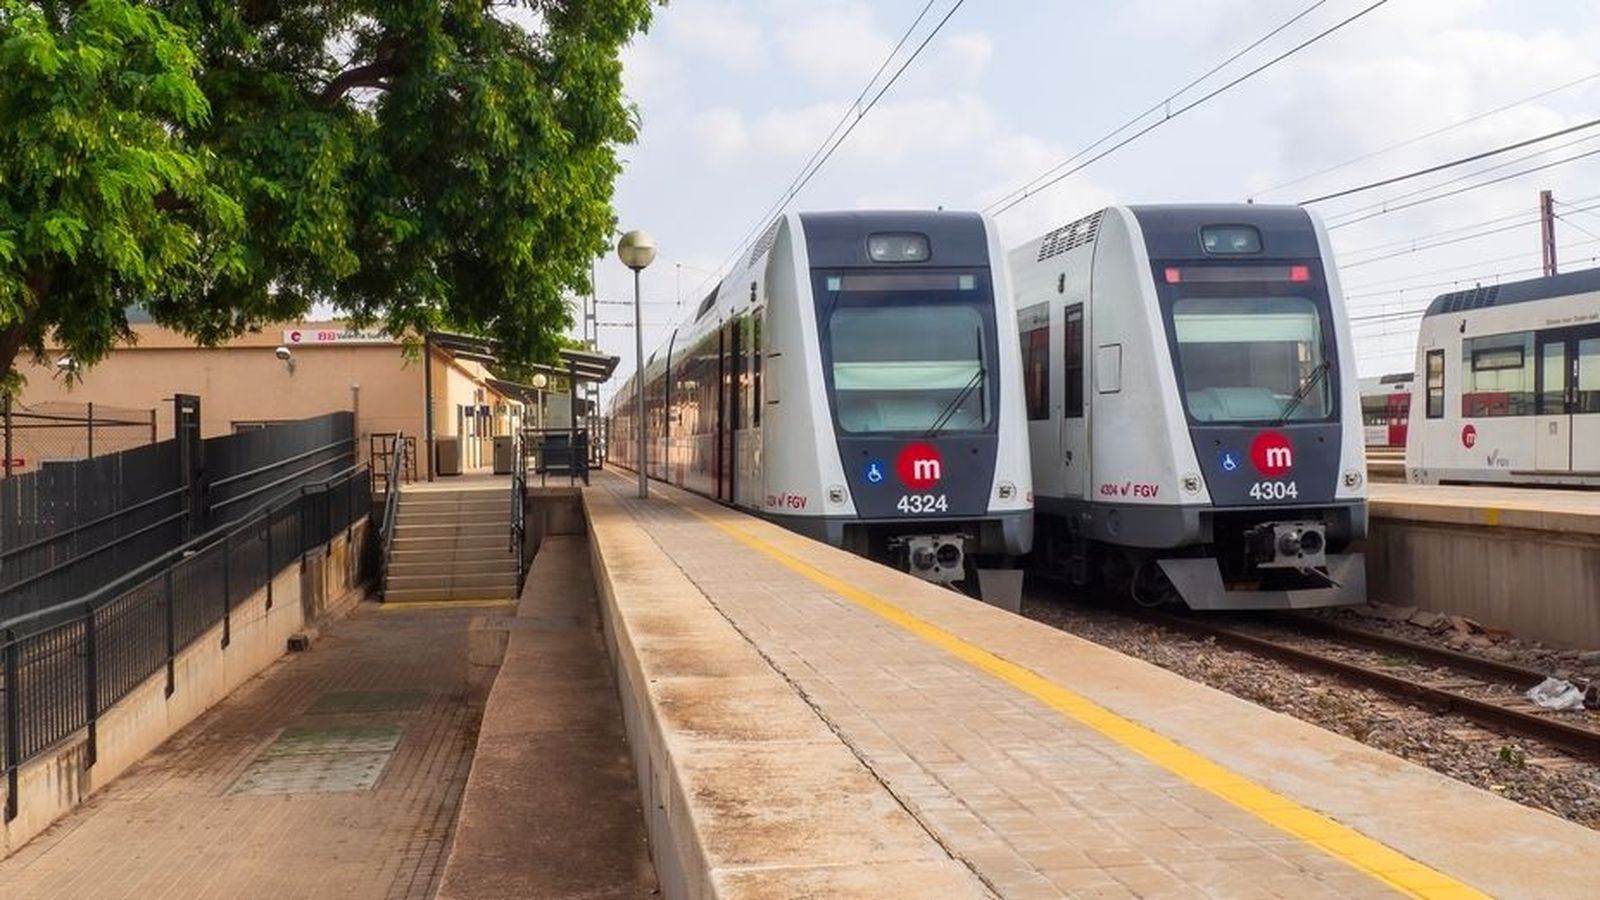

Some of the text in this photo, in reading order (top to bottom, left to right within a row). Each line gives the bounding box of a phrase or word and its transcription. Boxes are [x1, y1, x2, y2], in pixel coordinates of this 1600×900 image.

[1266, 446, 1292, 468] m
[913, 458, 940, 480] m
[1133, 484, 1159, 498] FGV
[1249, 481, 1298, 499] 4304
[787, 495, 807, 509] FGV
[897, 494, 948, 513] 4324
